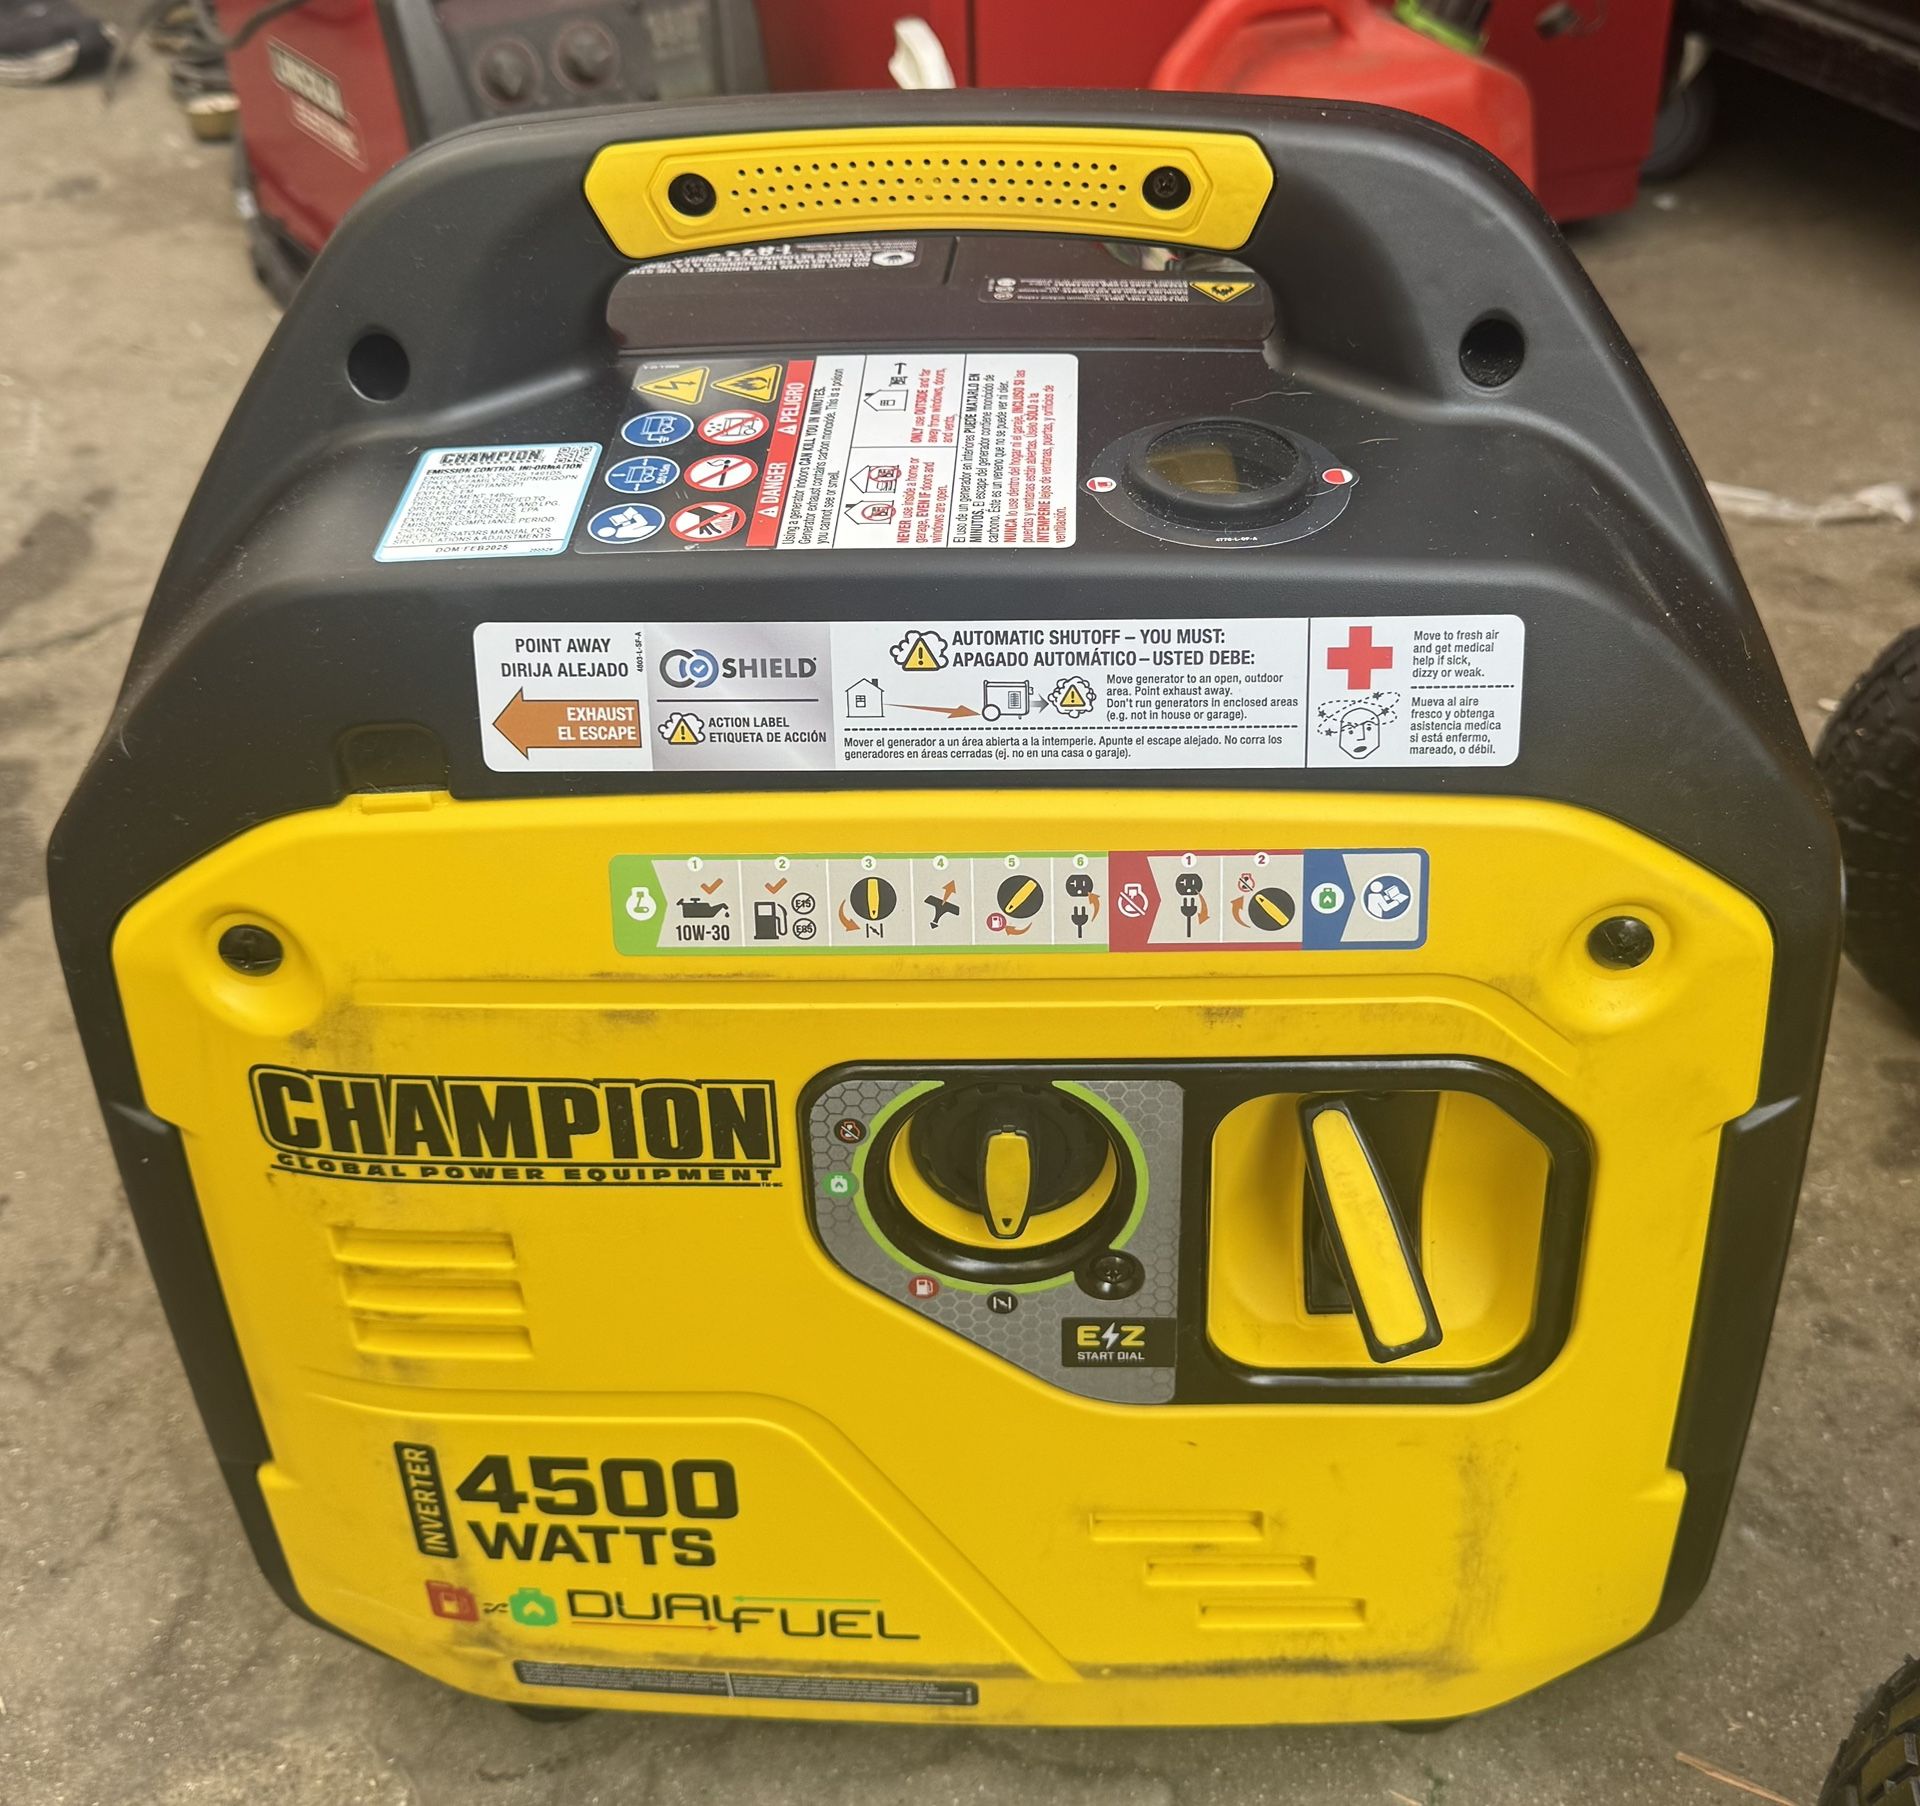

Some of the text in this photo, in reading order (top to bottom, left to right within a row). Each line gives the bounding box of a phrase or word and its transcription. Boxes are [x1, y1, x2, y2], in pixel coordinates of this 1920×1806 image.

[780, 382, 805, 422] PELIGRO
[804, 423, 819, 436] YOU
[801, 436, 816, 451] KILL
[440, 450, 542, 463] CHAMPION
[797, 451, 812, 465] CAN
[760, 462, 788, 504] DANGER
[781, 525, 798, 544] Using
[951, 629, 1044, 645] AUTOMATIC
[1048, 628, 1120, 645] SHUTOFF
[1139, 628, 1171, 644] YOU
[1176, 627, 1224, 643] MUST:
[1413, 628, 1499, 640] Move to fresh air
[514, 637, 610, 653] POINT AWAY
[1412, 641, 1494, 655] and get medical
[951, 651, 1028, 667] APAGADO
[1032, 647, 1136, 666] AUTOMÁTICO
[1152, 649, 1203, 665] USTED
[1209, 649, 1254, 665] DEBE:
[1412, 654, 1470, 667] help if sick,
[500, 661, 628, 677] DIRIJA ALEJADO
[722, 657, 814, 679] SHIELD
[1411, 666, 1484, 679] dizzy or weak.
[1106, 672, 1283, 687] Move generator to an open, outdoor
[1105, 685, 1232, 697] area. Point exhaust away.
[1106, 696, 1298, 709] Don't run generators in enclosed areas
[1410, 695, 1478, 706] Mueva al aire
[566, 706, 634, 720] EXHAUST
[1105, 708, 1247, 722] (e.g. not in house or garage).
[1410, 708, 1494, 720] fresco y obtenga
[707, 716, 789, 727] ACTION LABEL
[1409, 719, 1501, 730] asistencia medica
[557, 725, 636, 740] EL ESCAPE
[708, 729, 826, 743] ETIQUETA DE ACCIÓN
[1410, 731, 1490, 743] si está enfermo,
[843, 736, 873, 747] Mover
[876, 737, 884, 747] el
[886, 736, 936, 749] generador
[961, 735, 983, 746] área
[984, 735, 1020, 746] abierta
[1022, 738, 1028, 746] a
[1031, 736, 1039, 746] la
[1041, 735, 1096, 747] intemperie.
[1098, 735, 1133, 747] Apunte
[1135, 736, 1144, 745] el
[1146, 736, 1181, 747] escape
[1183, 734, 1221, 746] alejado.
[1224, 735, 1237, 744] No
[1239, 735, 1265, 744] corra
[1268, 735, 1282, 744] los
[843, 748, 904, 760] generadores
[920, 747, 948, 758] áreas
[949, 748, 992, 758] cerradas
[994, 747, 1009, 760] (ej.
[1040, 749, 1059, 757] una
[1060, 749, 1084, 757] casa
[1094, 747, 1131, 759] garaje).
[1408, 743, 1495, 755] mareado, o débil.
[675, 924, 730, 942] 10W-30
[256, 1070, 776, 1162] CHAMPION
[276, 1152, 773, 1181] GLOBAL POWER EQUIPMENT
[1077, 1351, 1145, 1360] START DIAL
[456, 1454, 740, 1520] 4500
[403, 1447, 449, 1553] INVERTER
[466, 1520, 717, 1567] WATTS
